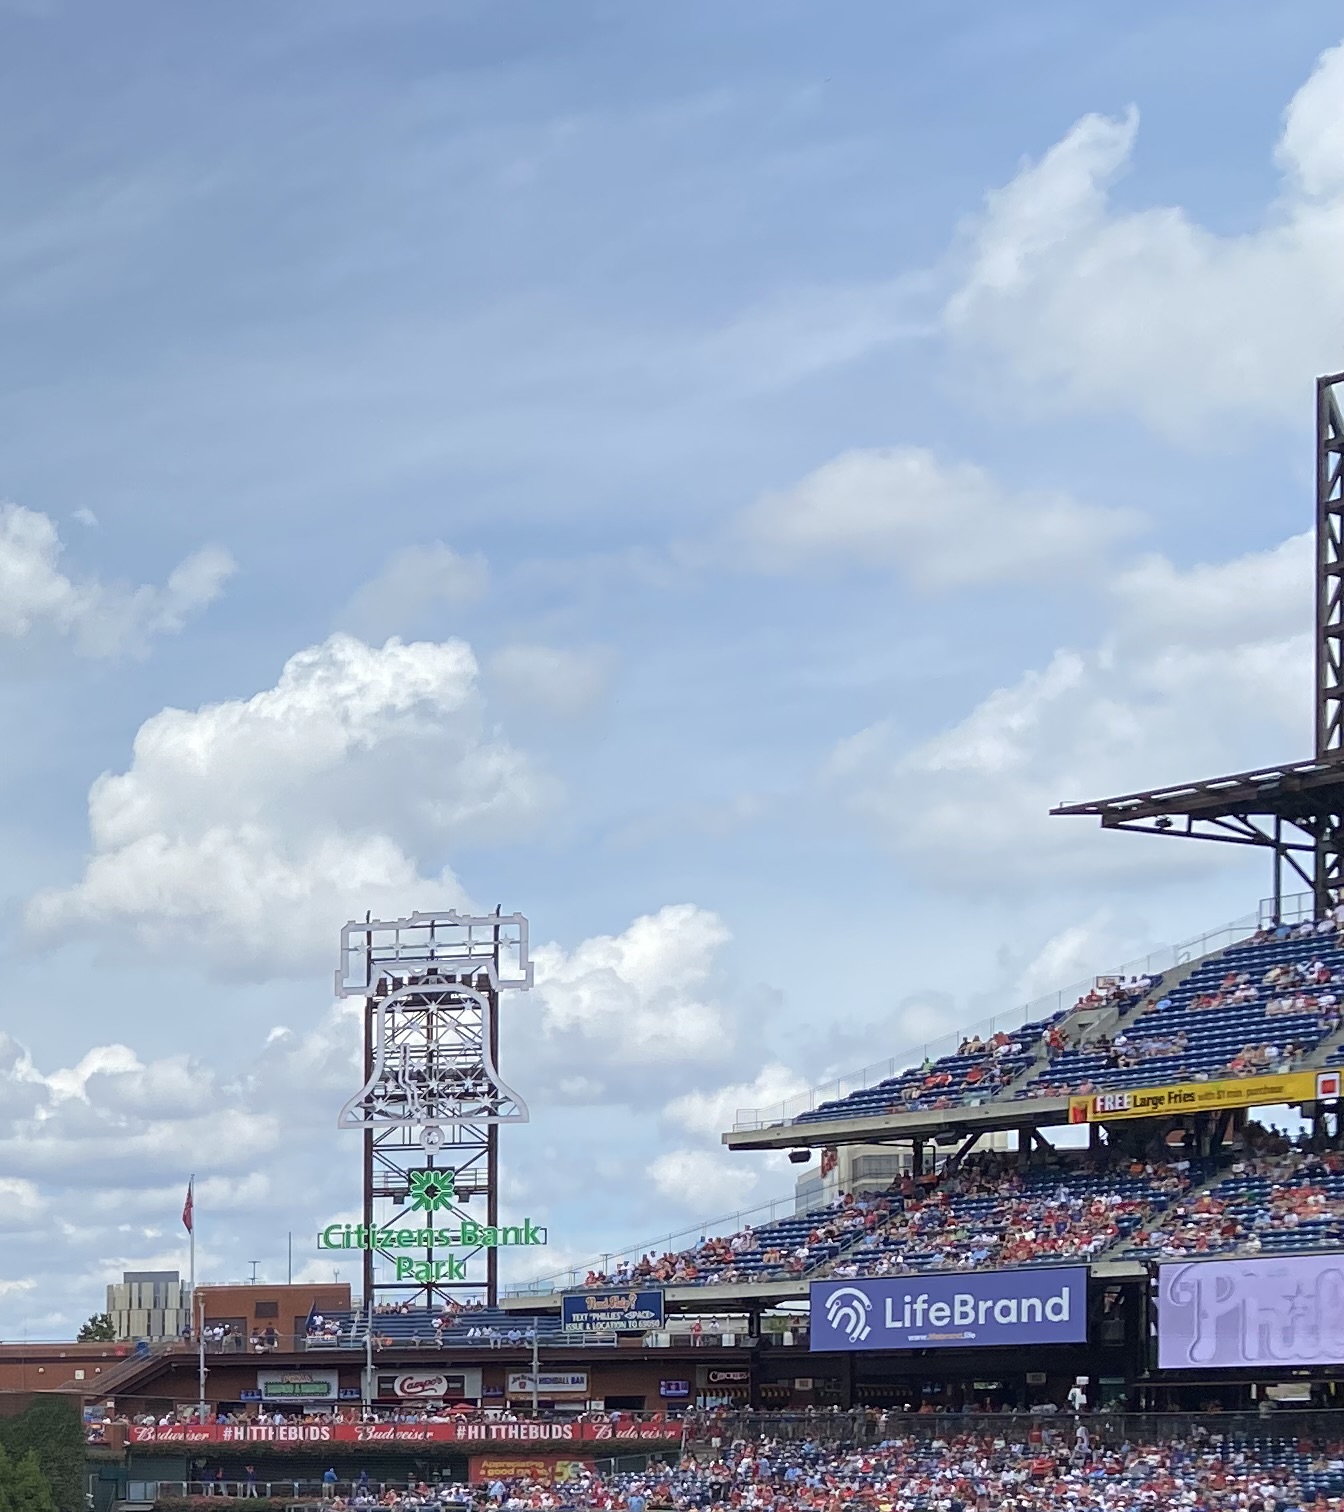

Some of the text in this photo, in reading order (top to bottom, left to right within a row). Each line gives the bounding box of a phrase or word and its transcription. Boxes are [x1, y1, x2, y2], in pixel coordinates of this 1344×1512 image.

[1094, 1091, 1195, 1113] FREE Large Fries
[322, 1218, 541, 1249] Citizens Bank
[396, 1254, 467, 1281] Park
[885, 1286, 1070, 1330] LifeBrand
[134, 1426, 209, 1441] Budweiser
[354, 1426, 433, 1441] Budweiser
[457, 1424, 572, 1440] #HITTHEBUDS
